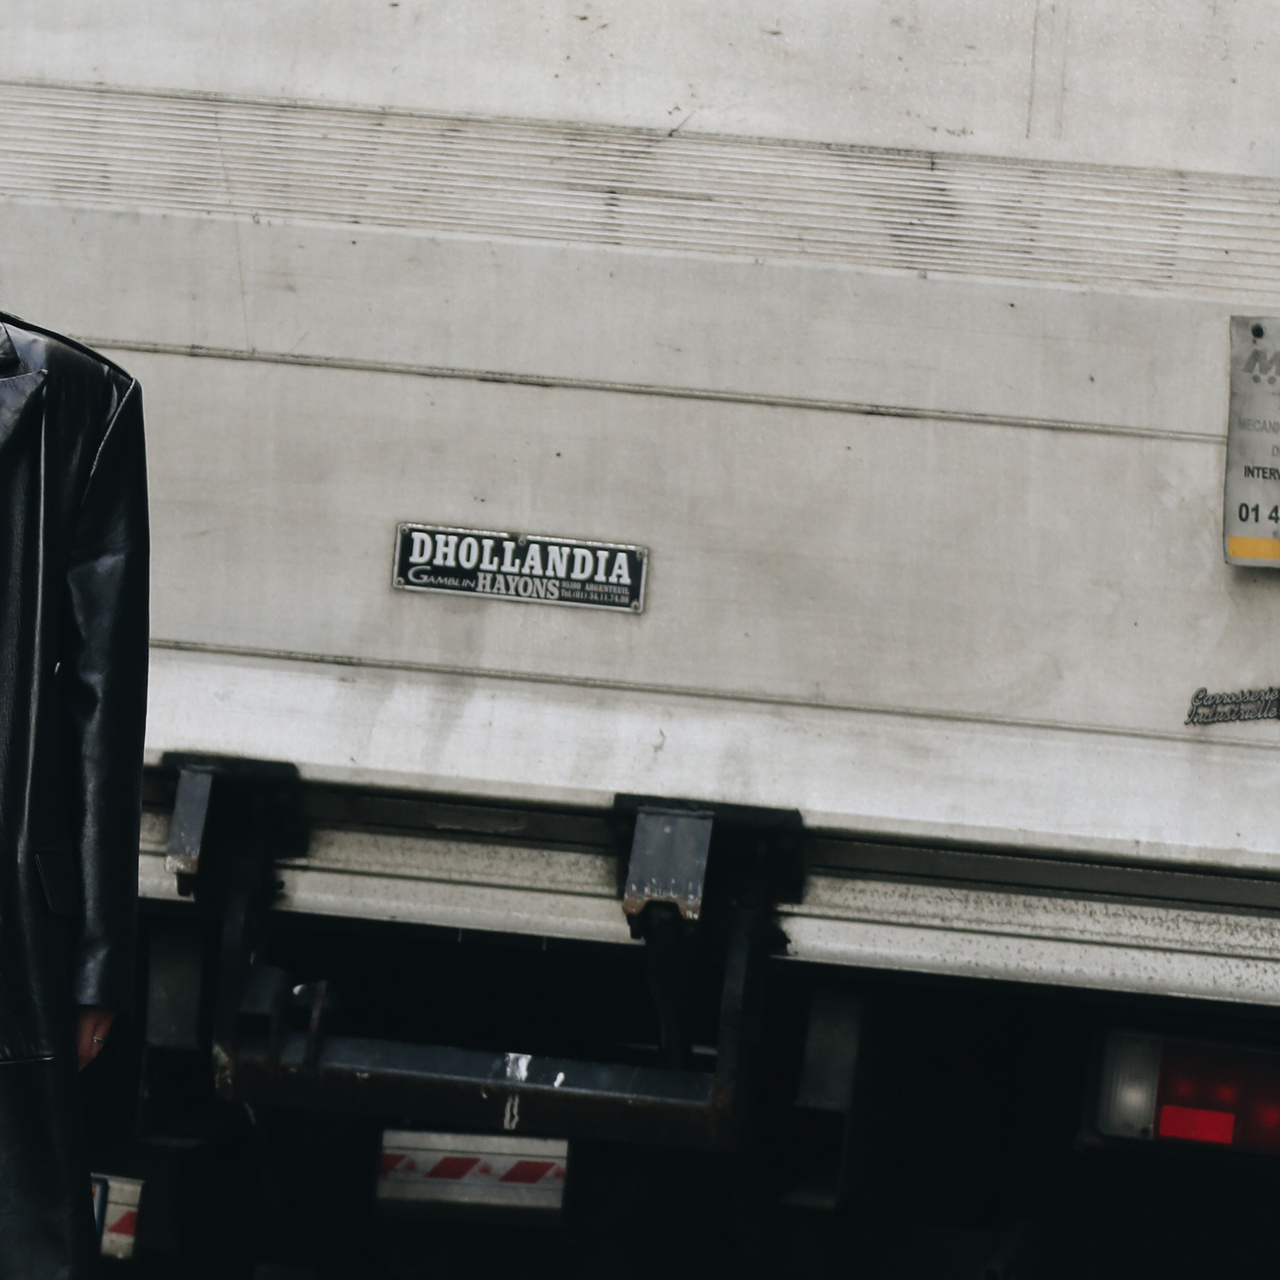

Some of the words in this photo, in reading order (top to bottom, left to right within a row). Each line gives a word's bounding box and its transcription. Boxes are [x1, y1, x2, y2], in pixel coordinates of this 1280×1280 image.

[1238, 502, 1260, 523] 01
[409, 532, 631, 585] DHOLLANDIA
[475, 571, 560, 600] HAYONS
[1191, 687, 1279, 707] Carrosserie
